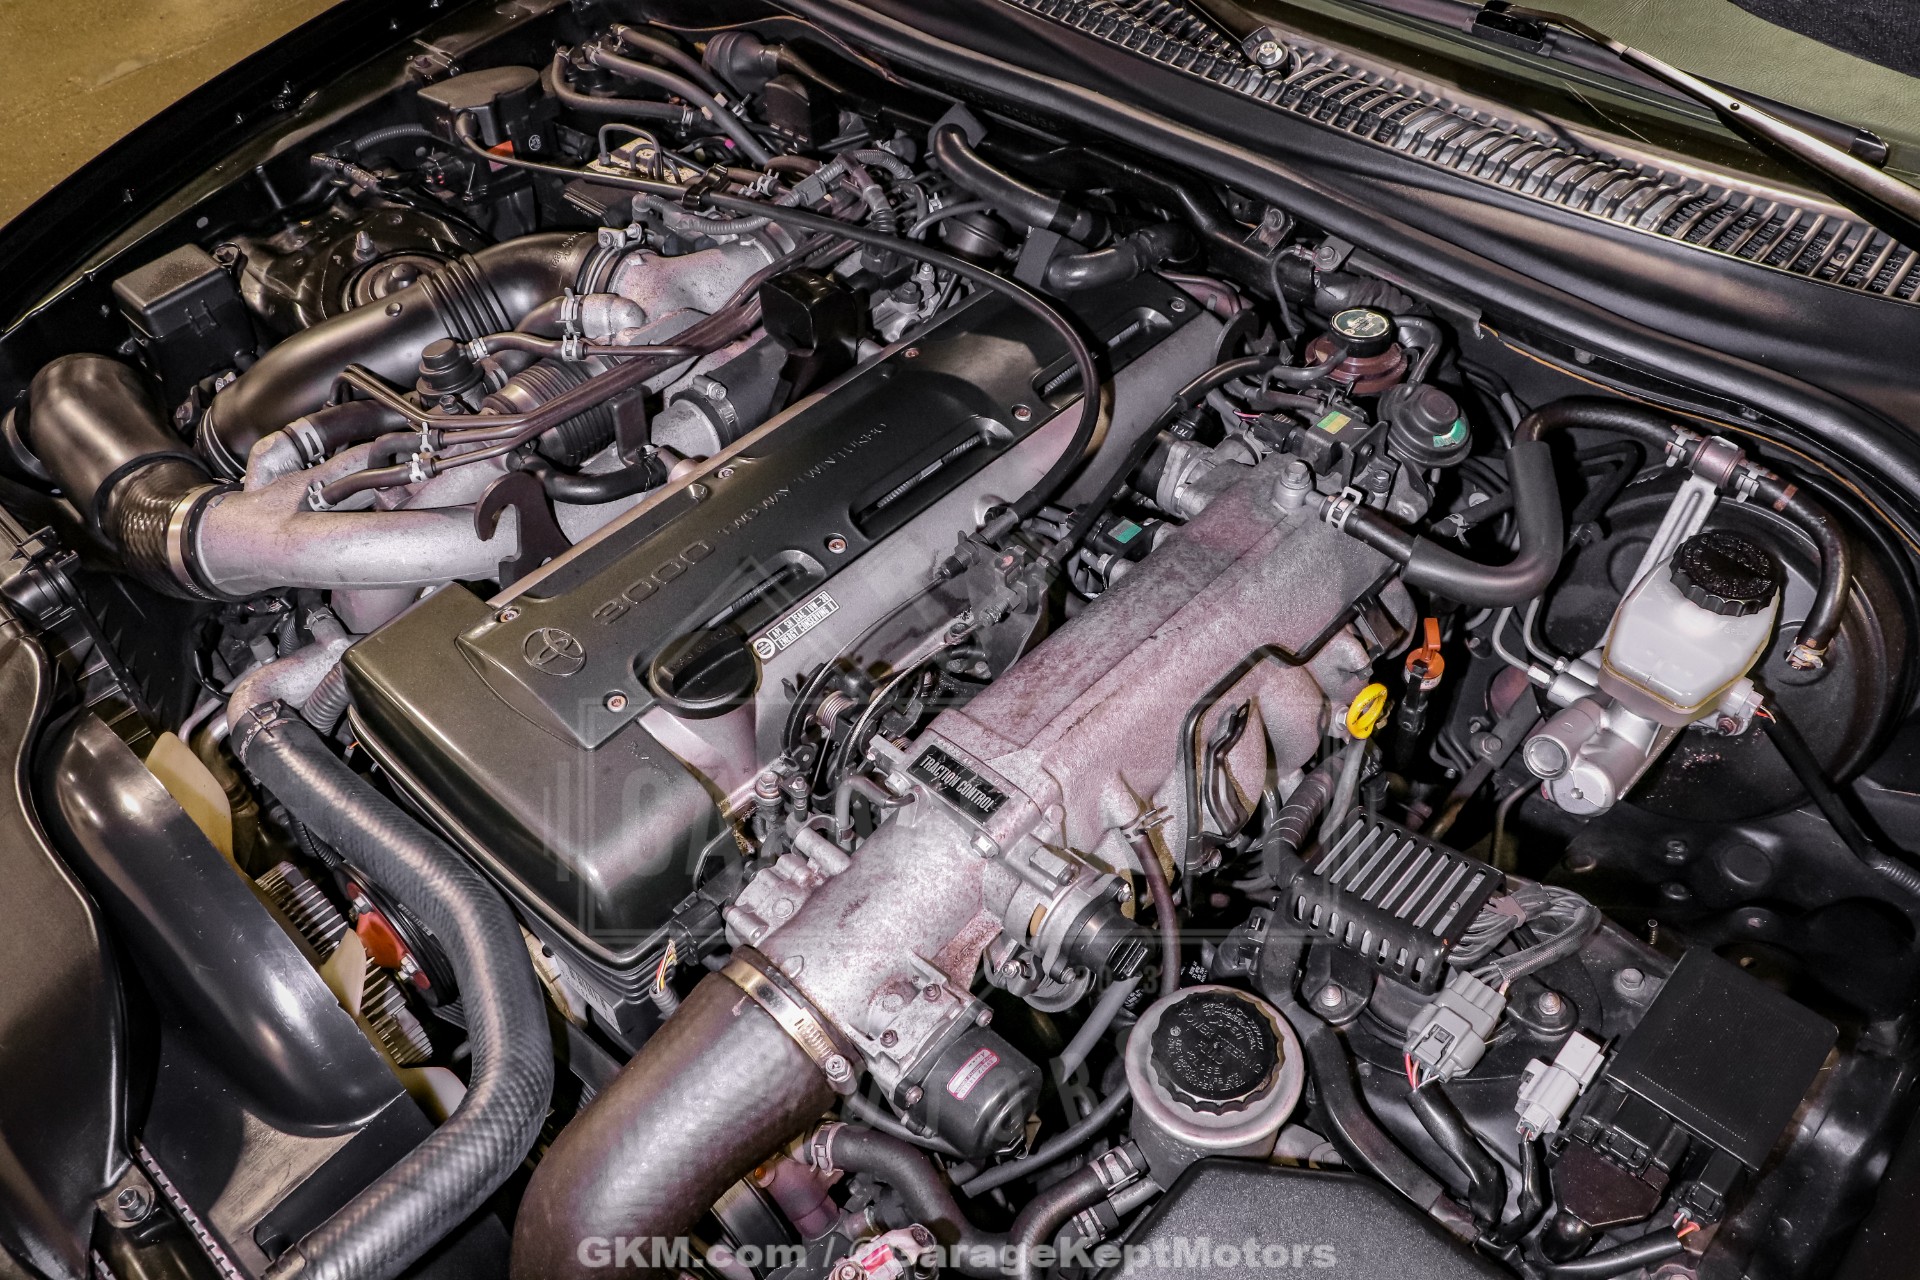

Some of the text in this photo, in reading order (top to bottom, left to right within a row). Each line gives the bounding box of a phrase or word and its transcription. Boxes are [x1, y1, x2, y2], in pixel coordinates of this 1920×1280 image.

[592, 421, 888, 625] 3000 TWO WAY TWIN TURBO
[771, 626, 784, 639] API
[783, 619, 795, 629] SH
[793, 610, 807, 623] SAE
[779, 628, 800, 647] ENERGY
[797, 606, 831, 632] CONSERVING
[919, 755, 962, 788] TRACTION
[955, 780, 995, 813] CONTROL
